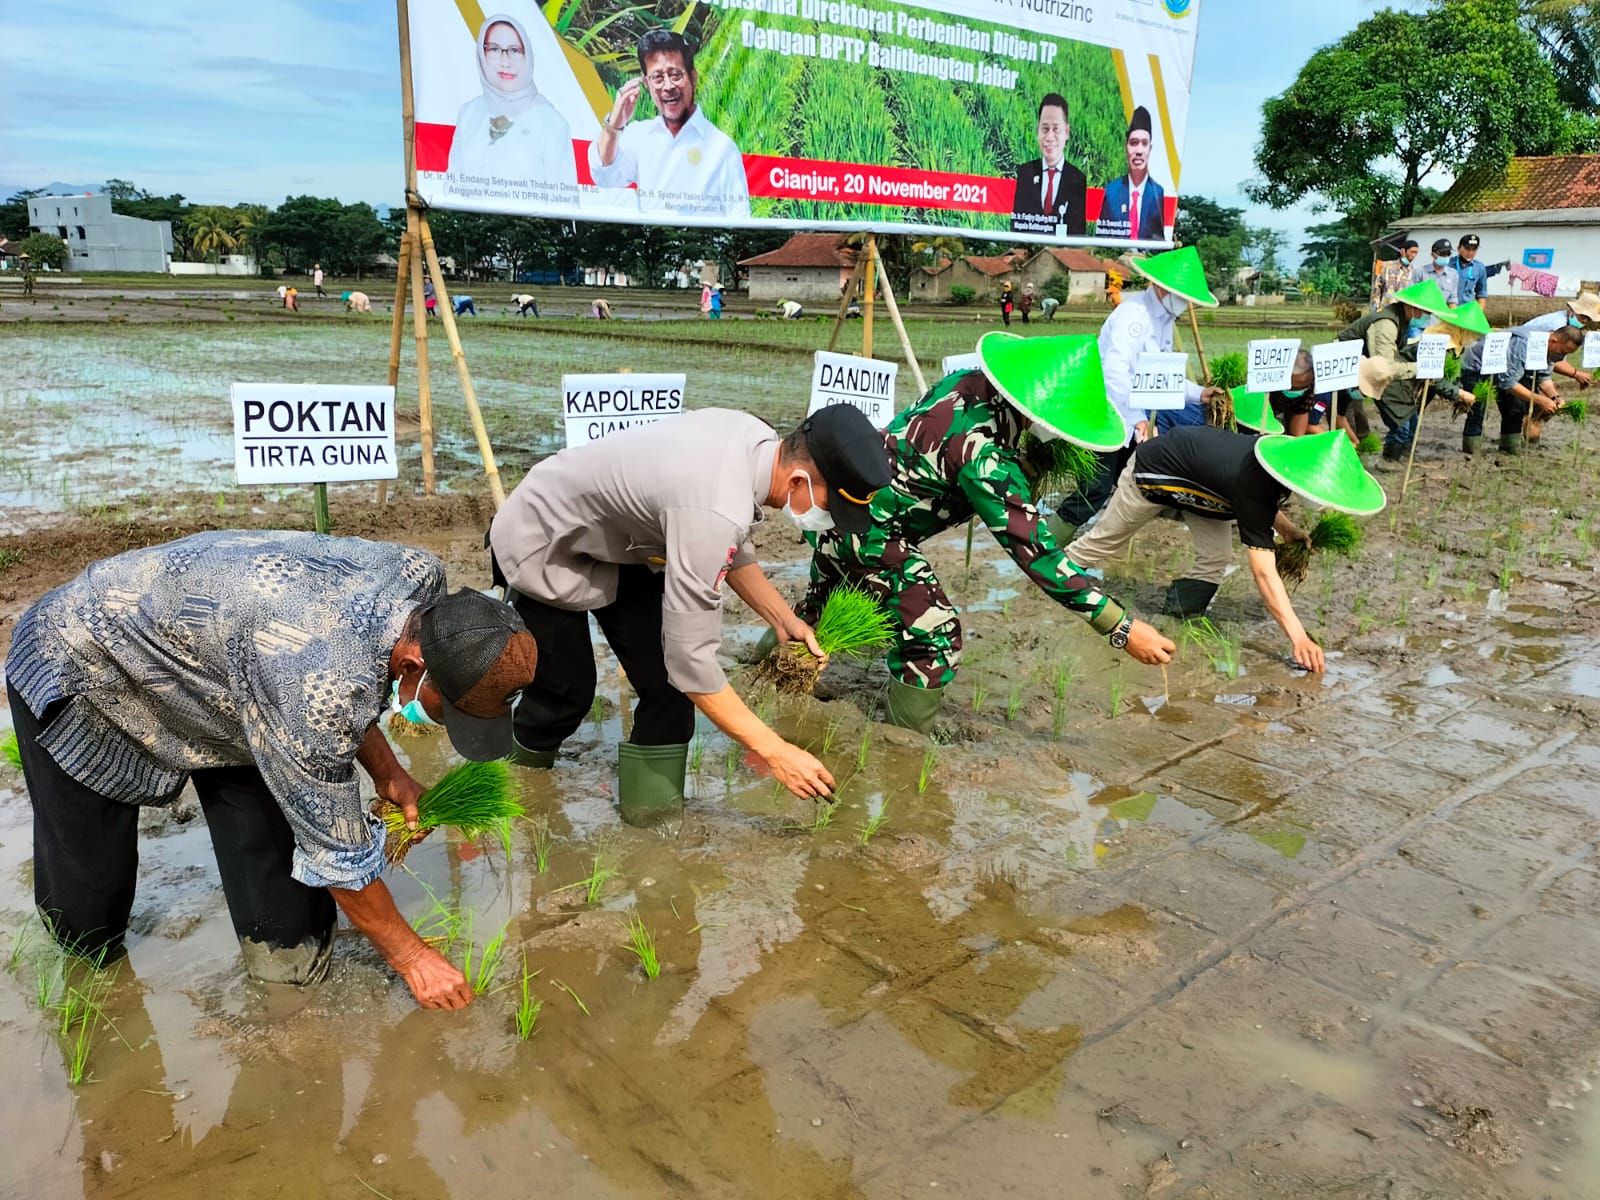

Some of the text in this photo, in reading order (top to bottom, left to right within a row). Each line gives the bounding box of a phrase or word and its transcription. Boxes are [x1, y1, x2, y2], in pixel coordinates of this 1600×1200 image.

[801, 0, 893, 34] Direktorat
[897, 11, 990, 52] Perbenihan
[993, 30, 1037, 61] Ditjen
[1039, 41, 1057, 64] TP
[741, 20, 1019, 90] Dengan BPTP Balitbangtan Jabar
[448, 185, 483, 198] Anggota
[484, 187, 511, 199] Komisi
[512, 190, 520, 200] IV
[522, 191, 549, 201] DPR-RI
[460, 174, 490, 186] Endang
[492, 176, 528, 188] Setyawati
[530, 180, 559, 191] Thohari
[769, 167, 988, 204] Cianjur, 20 November 2021
[1254, 347, 1292, 366] BUPATI
[1316, 356, 1359, 378] BBP2TP
[820, 363, 890, 396] DANDIM
[1132, 373, 1184, 390] DITJEN TP
[1256, 370, 1285, 384] CIANJUR
[566, 389, 681, 413] KAPOLRES
[826, 397, 880, 418] CJUR
[244, 400, 386, 433] POKTAN
[588, 419, 659, 440] CIAN
[244, 444, 389, 468] TIRTA GUNA
